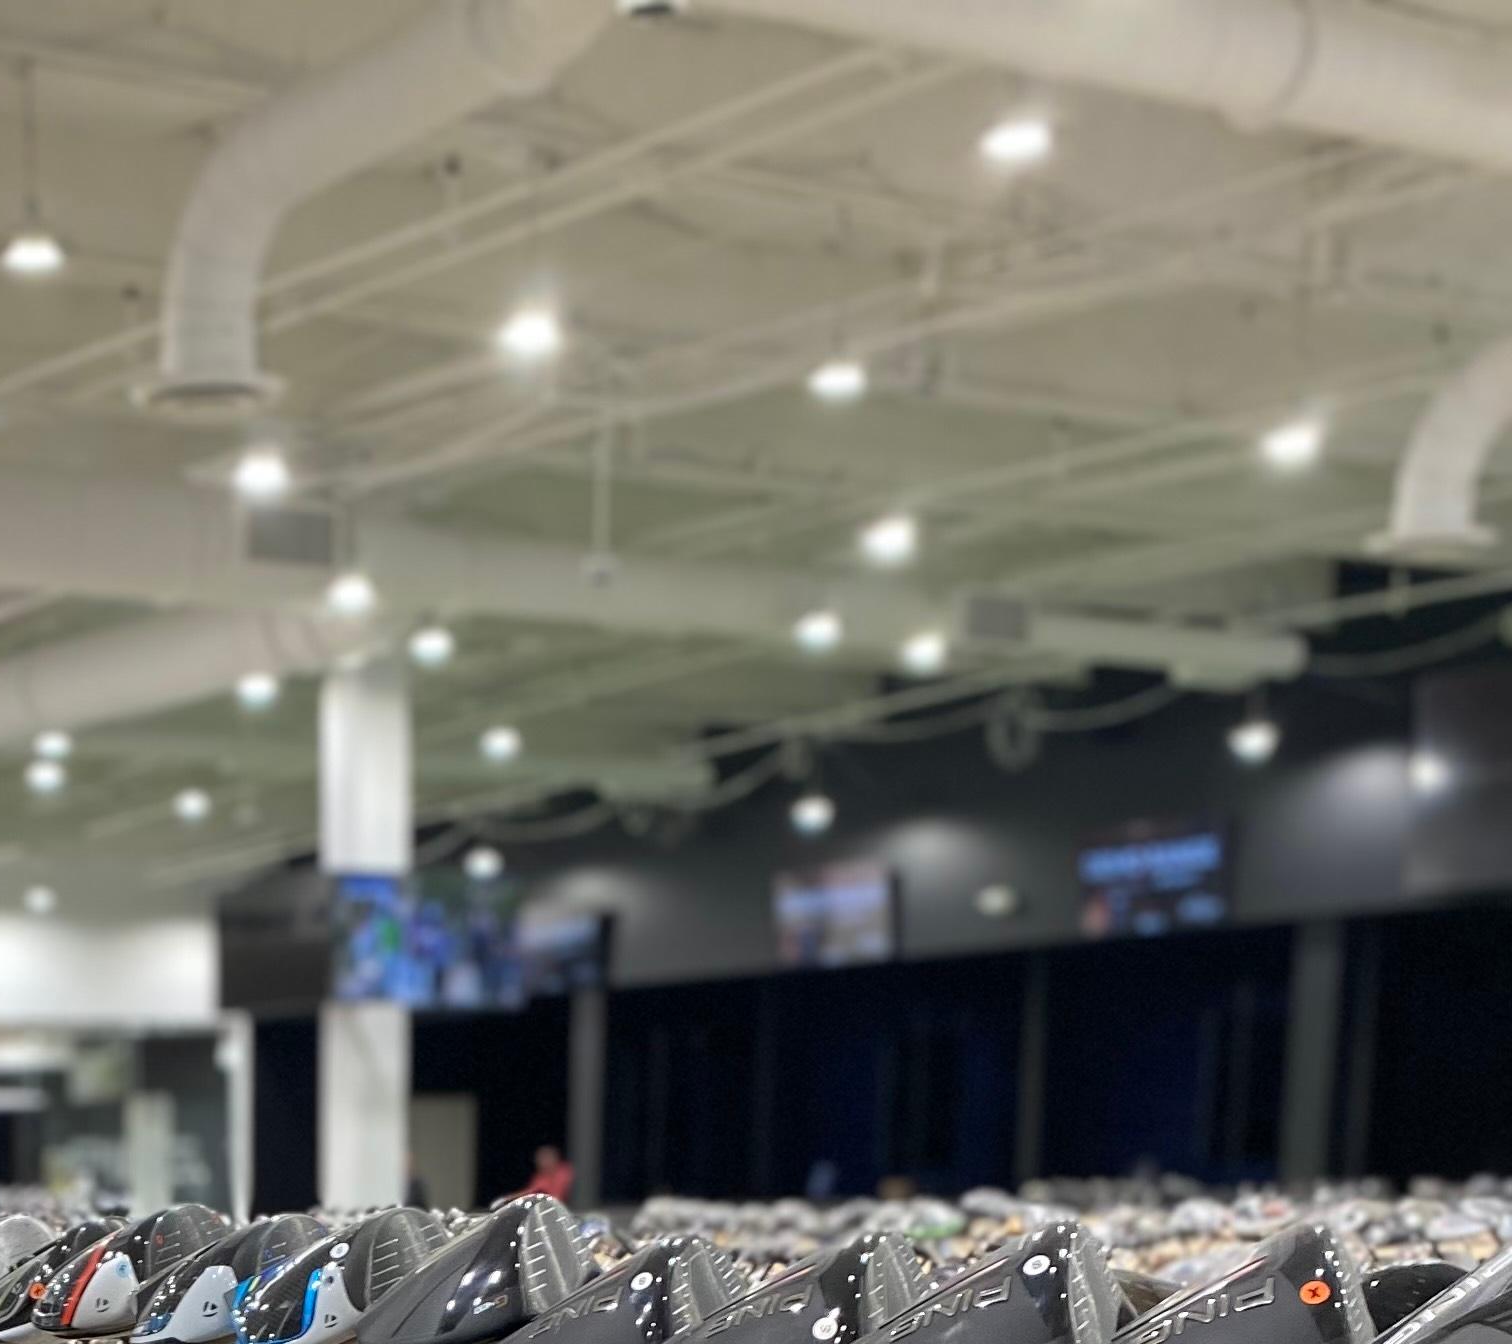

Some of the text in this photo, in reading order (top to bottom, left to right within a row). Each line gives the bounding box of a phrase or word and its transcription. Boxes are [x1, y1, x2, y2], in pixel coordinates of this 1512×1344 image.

[528, 1287, 622, 1339] PING
[705, 1285, 813, 1339] PING
[889, 1276, 1011, 1344] PING
[1307, 1287, 1321, 1299] X
